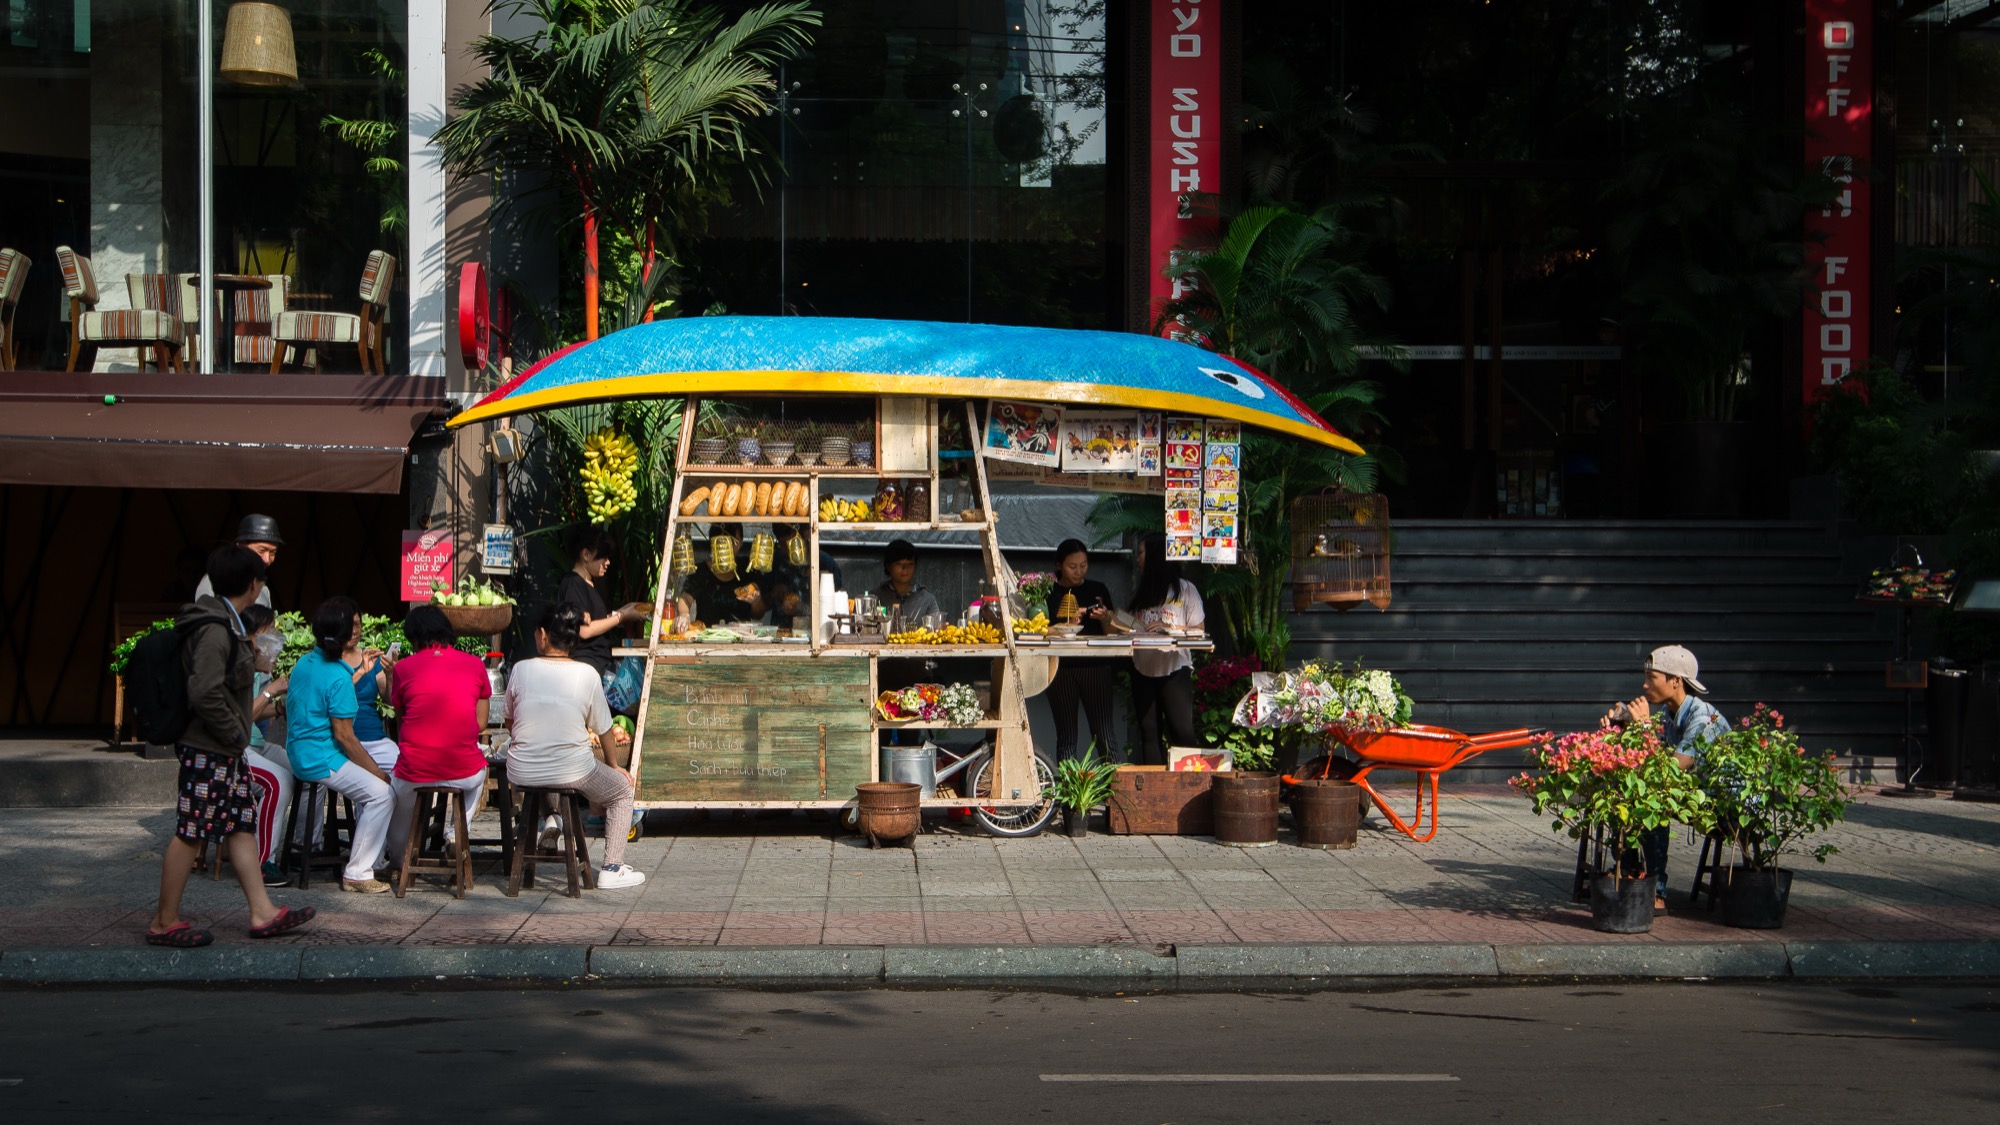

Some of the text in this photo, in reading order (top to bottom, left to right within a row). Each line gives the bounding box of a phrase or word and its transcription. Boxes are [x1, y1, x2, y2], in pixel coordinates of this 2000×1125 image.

[1170, 0, 1201, 57] YO
[1823, 20, 1855, 118] OFF
[1170, 88, 1201, 219] SUSHI
[1820, 256, 1852, 386] FOOD
[406, 552, 449, 565] Miễn phí
[414, 563, 429, 574] giữ
[688, 735, 713, 750] Hoa
